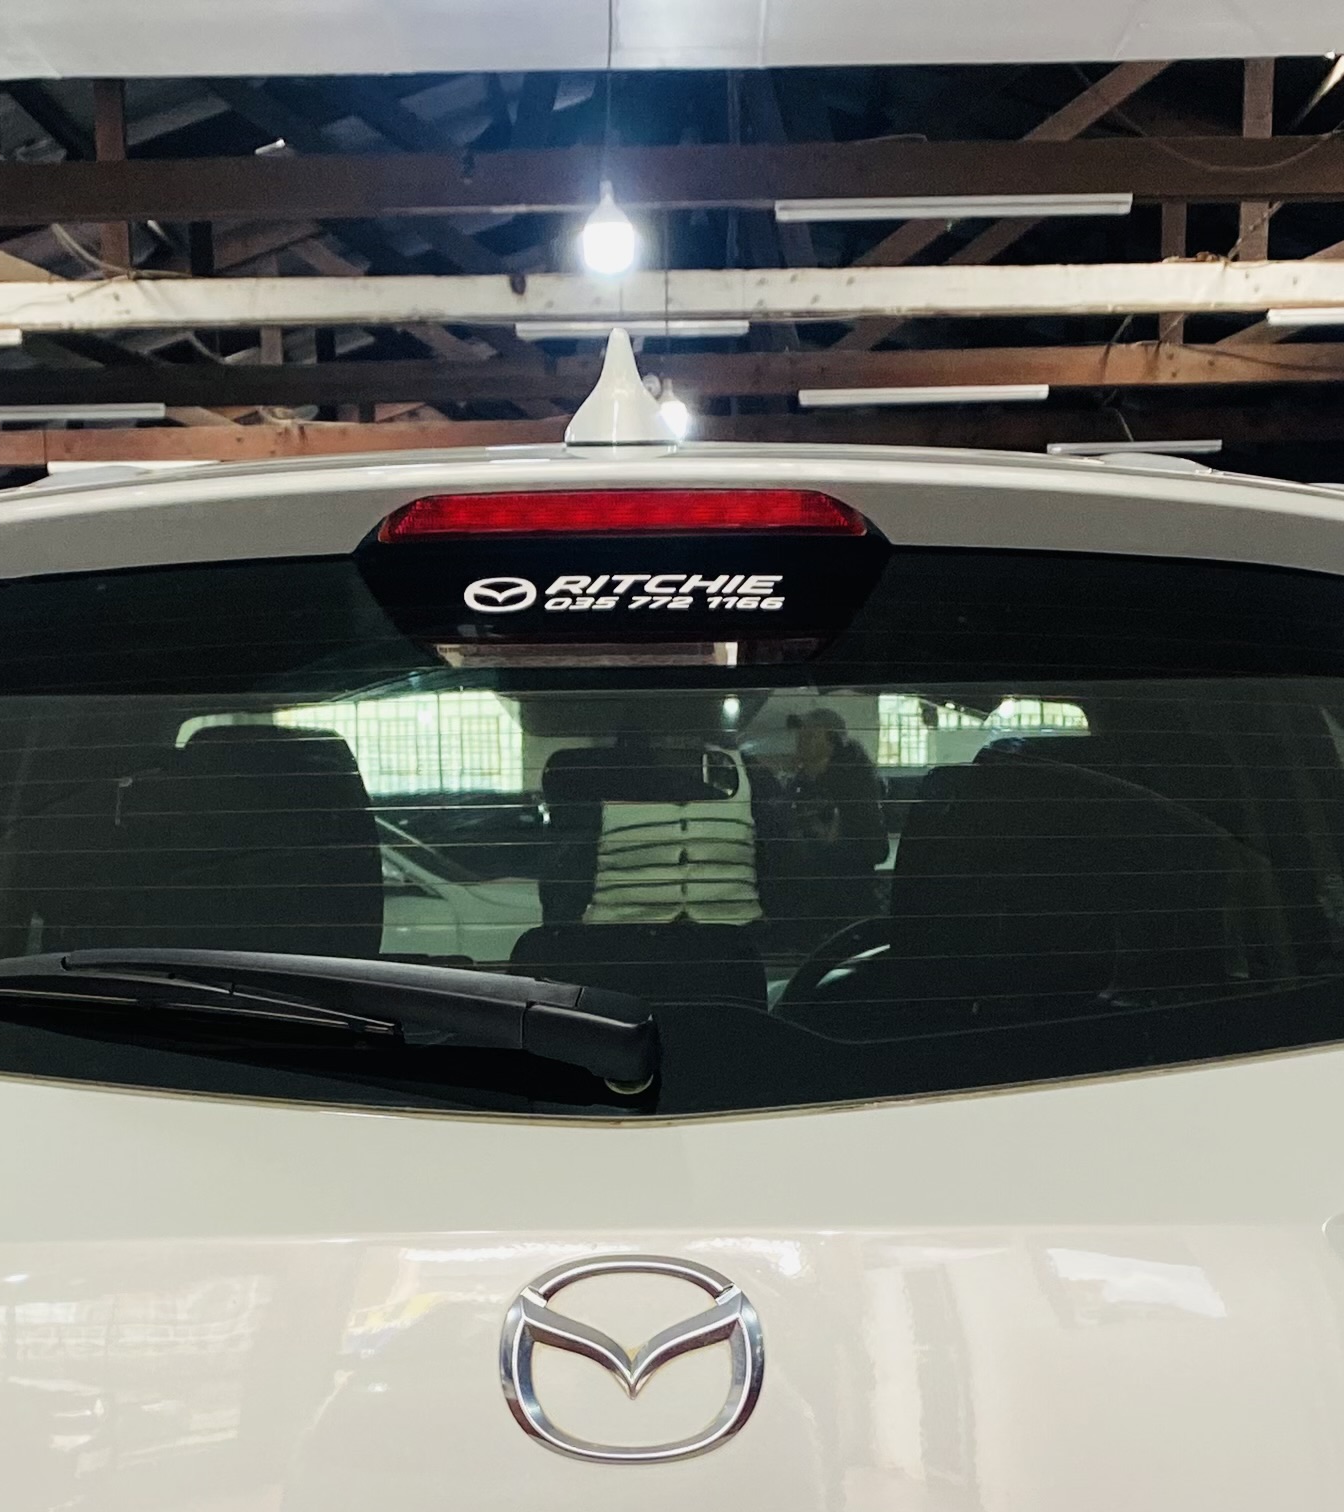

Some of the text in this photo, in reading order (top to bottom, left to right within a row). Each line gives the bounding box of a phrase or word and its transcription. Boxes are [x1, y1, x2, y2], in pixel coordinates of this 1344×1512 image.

[545, 574, 783, 595] RITCHIE
[544, 596, 785, 611] 035 772 1166
